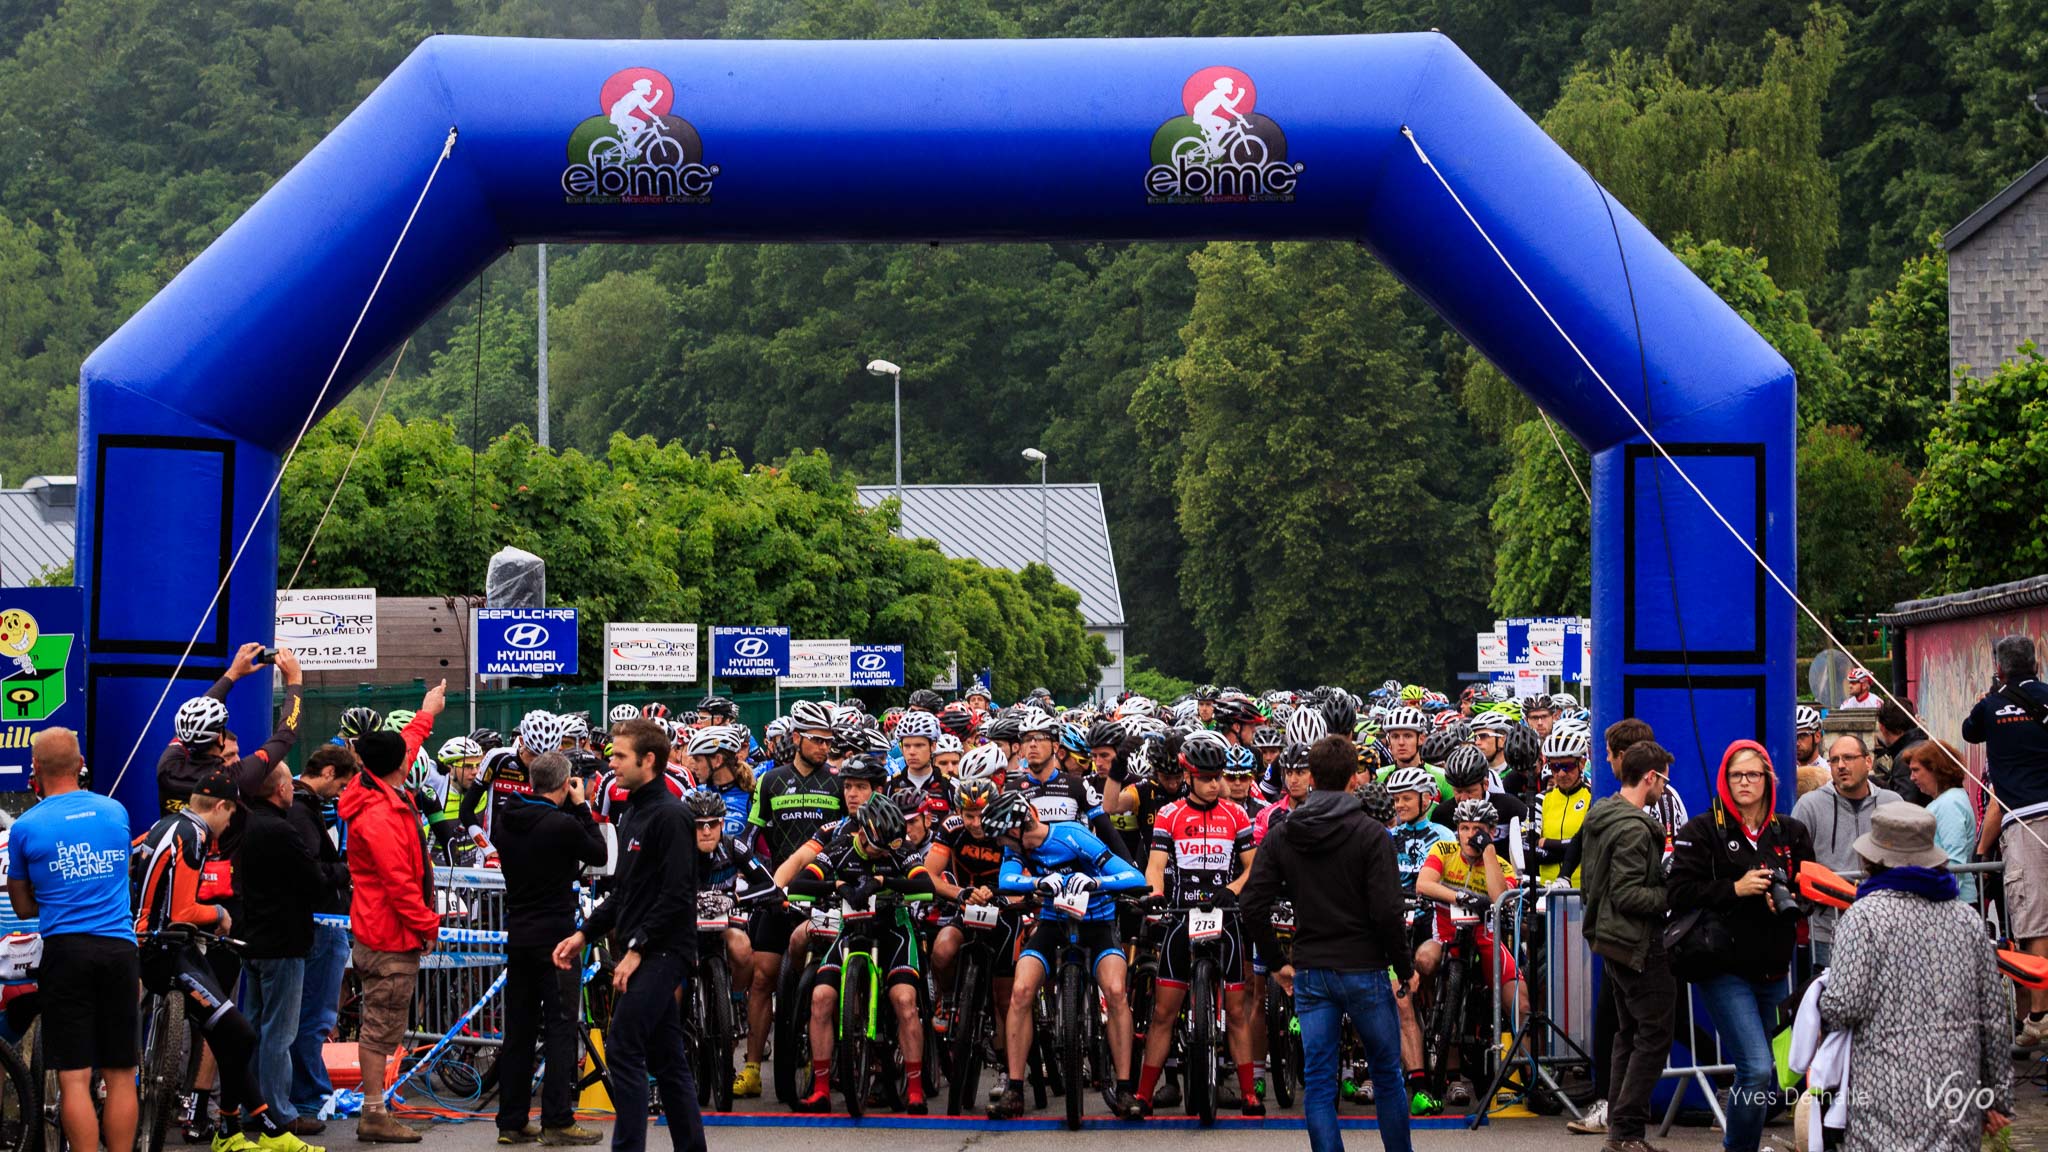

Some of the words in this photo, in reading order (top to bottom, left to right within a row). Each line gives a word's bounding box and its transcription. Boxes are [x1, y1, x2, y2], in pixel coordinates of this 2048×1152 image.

[275, 615, 373, 626] EPULCHRE
[312, 627, 373, 635] MALMEDY
[497, 650, 556, 661] HYUNDAI
[729, 658, 774, 667] HYUNDAI
[495, 782, 533, 792] ROTH
[777, 797, 833, 806] cannondale
[57, 842, 91, 859] RAID
[1179, 842, 1223, 855] Vano
[48, 856, 75, 872] DES
[76, 849, 125, 866] HAUTES
[62, 861, 114, 880] FAGNES
[975, 910, 988, 922] 17
[1194, 920, 1216, 932] 273
